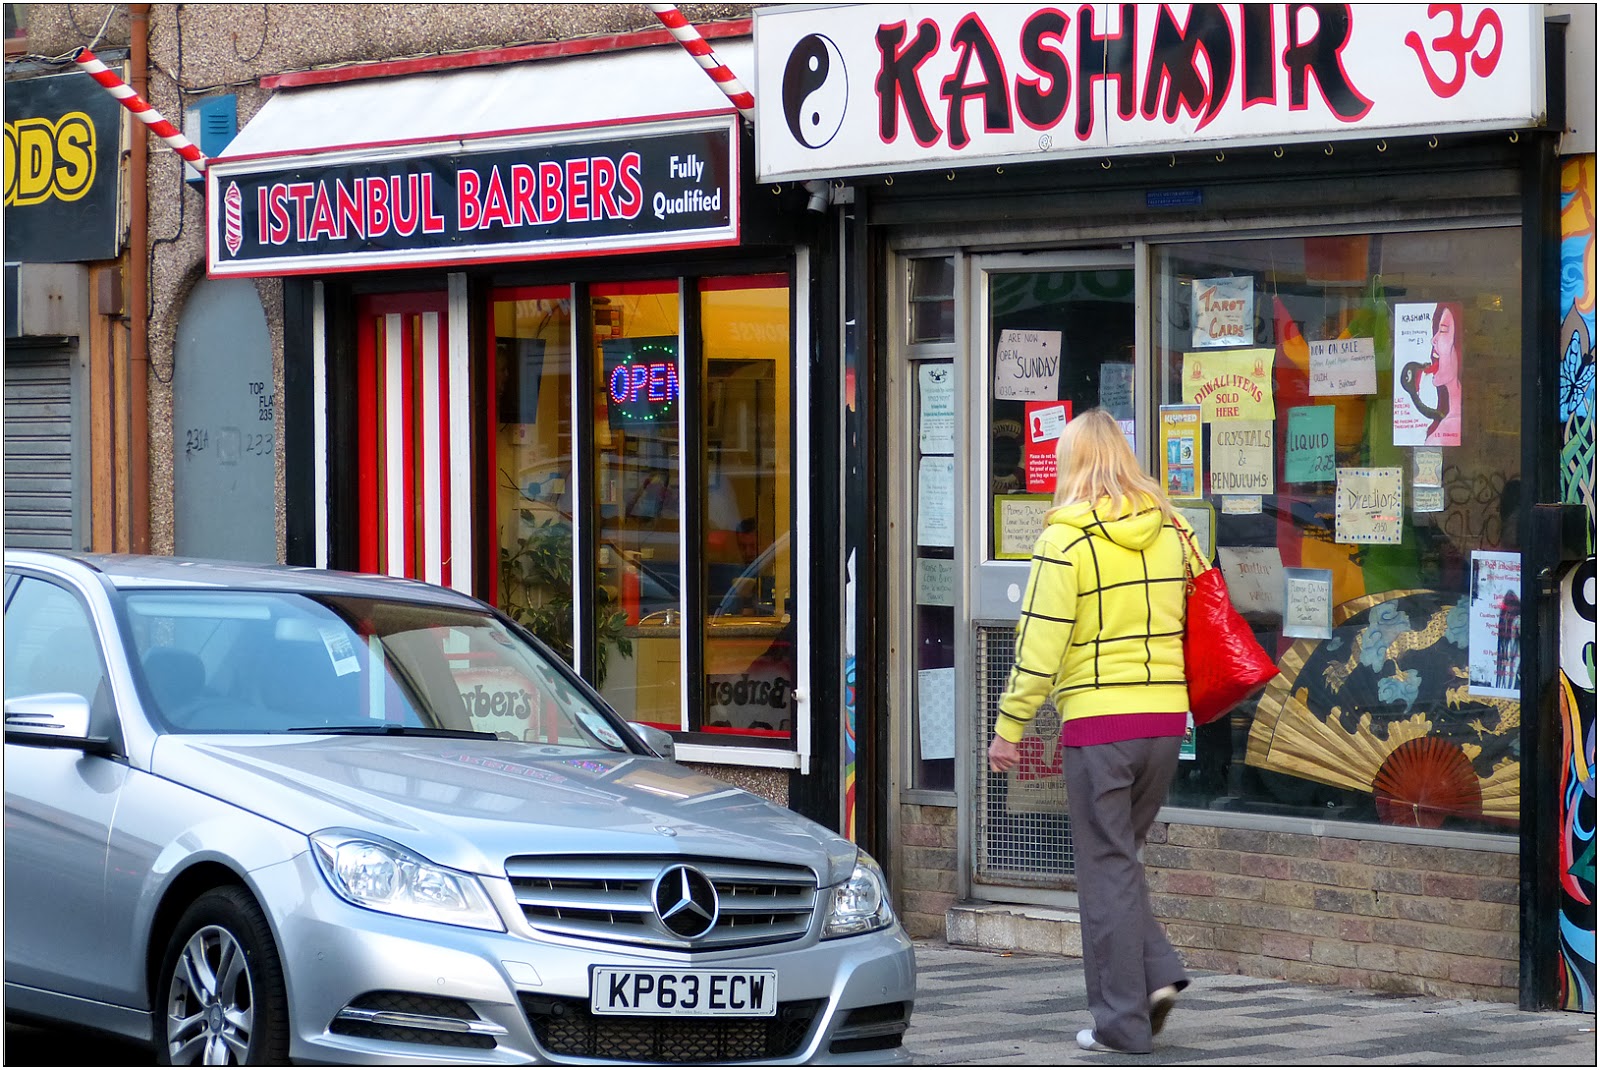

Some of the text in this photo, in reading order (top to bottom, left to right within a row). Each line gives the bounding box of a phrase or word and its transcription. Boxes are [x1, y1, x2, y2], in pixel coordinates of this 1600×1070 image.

[874, 3, 1375, 150] KASHMIR
[669, 153, 704, 182] Fully
[257, 151, 643, 246] ISTANBUL BARBERS
[652, 187, 721, 220] Qualified
[1328, 343, 1338, 355] ON
[1341, 340, 1358, 354] SALE
[1013, 356, 1058, 379] SUNDAY
[249, 382, 265, 394] TOP
[1194, 374, 1263, 405] DIWALI ITEMS
[259, 394, 275, 408] FLA
[1216, 393, 1239, 404] SOLD
[259, 408, 273, 421] 235
[1216, 406, 1240, 417] HERE
[1217, 429, 1271, 448] CRYSTALS
[1238, 449, 1247, 467] &
[1212, 471, 1269, 491] PENDULUMS
[608, 973, 766, 1010] KP63 ECW
